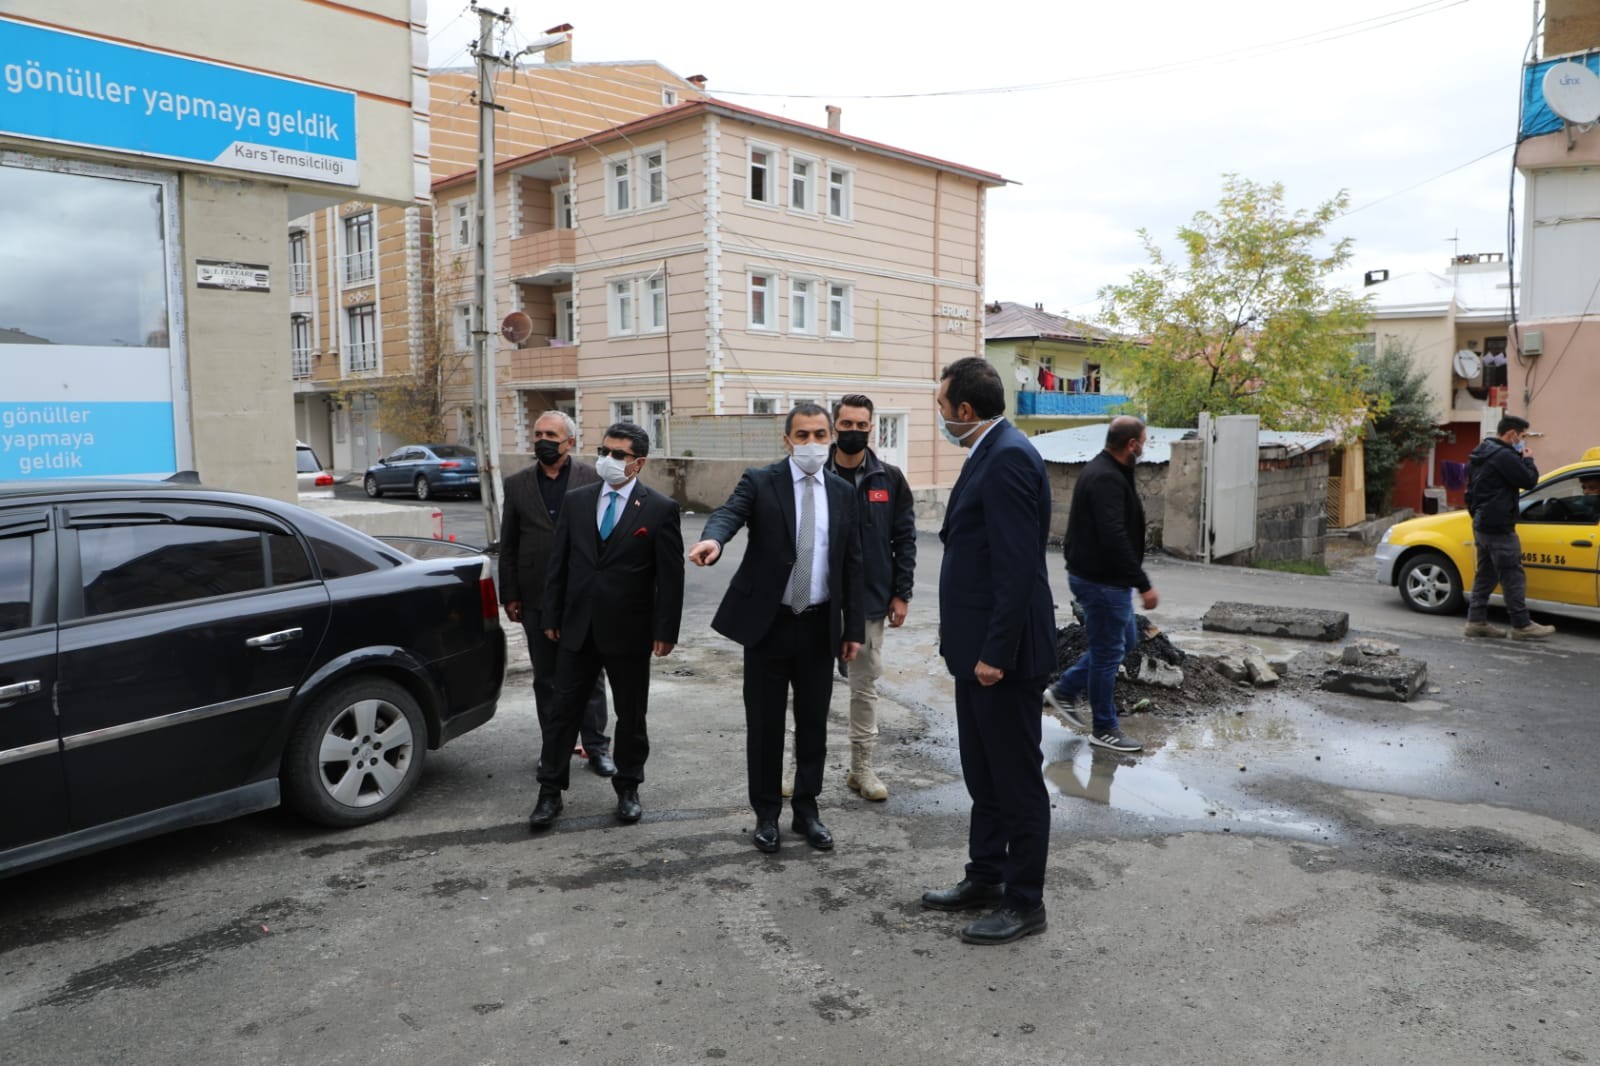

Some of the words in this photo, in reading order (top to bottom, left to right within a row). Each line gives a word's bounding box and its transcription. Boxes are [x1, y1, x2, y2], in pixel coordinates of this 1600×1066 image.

[4, 60, 137, 104] gönüller
[142, 87, 261, 131] yapmaya
[267, 109, 340, 141] geldik
[234, 144, 268, 161] Kars
[270, 150, 344, 175] Temsilciliği
[3, 406, 92, 428] gönüller
[1, 431, 95, 452] yapmaya
[19, 452, 83, 474] geldik
[1540, 554, 1552, 564] 36
[1554, 555, 1566, 565] 36
